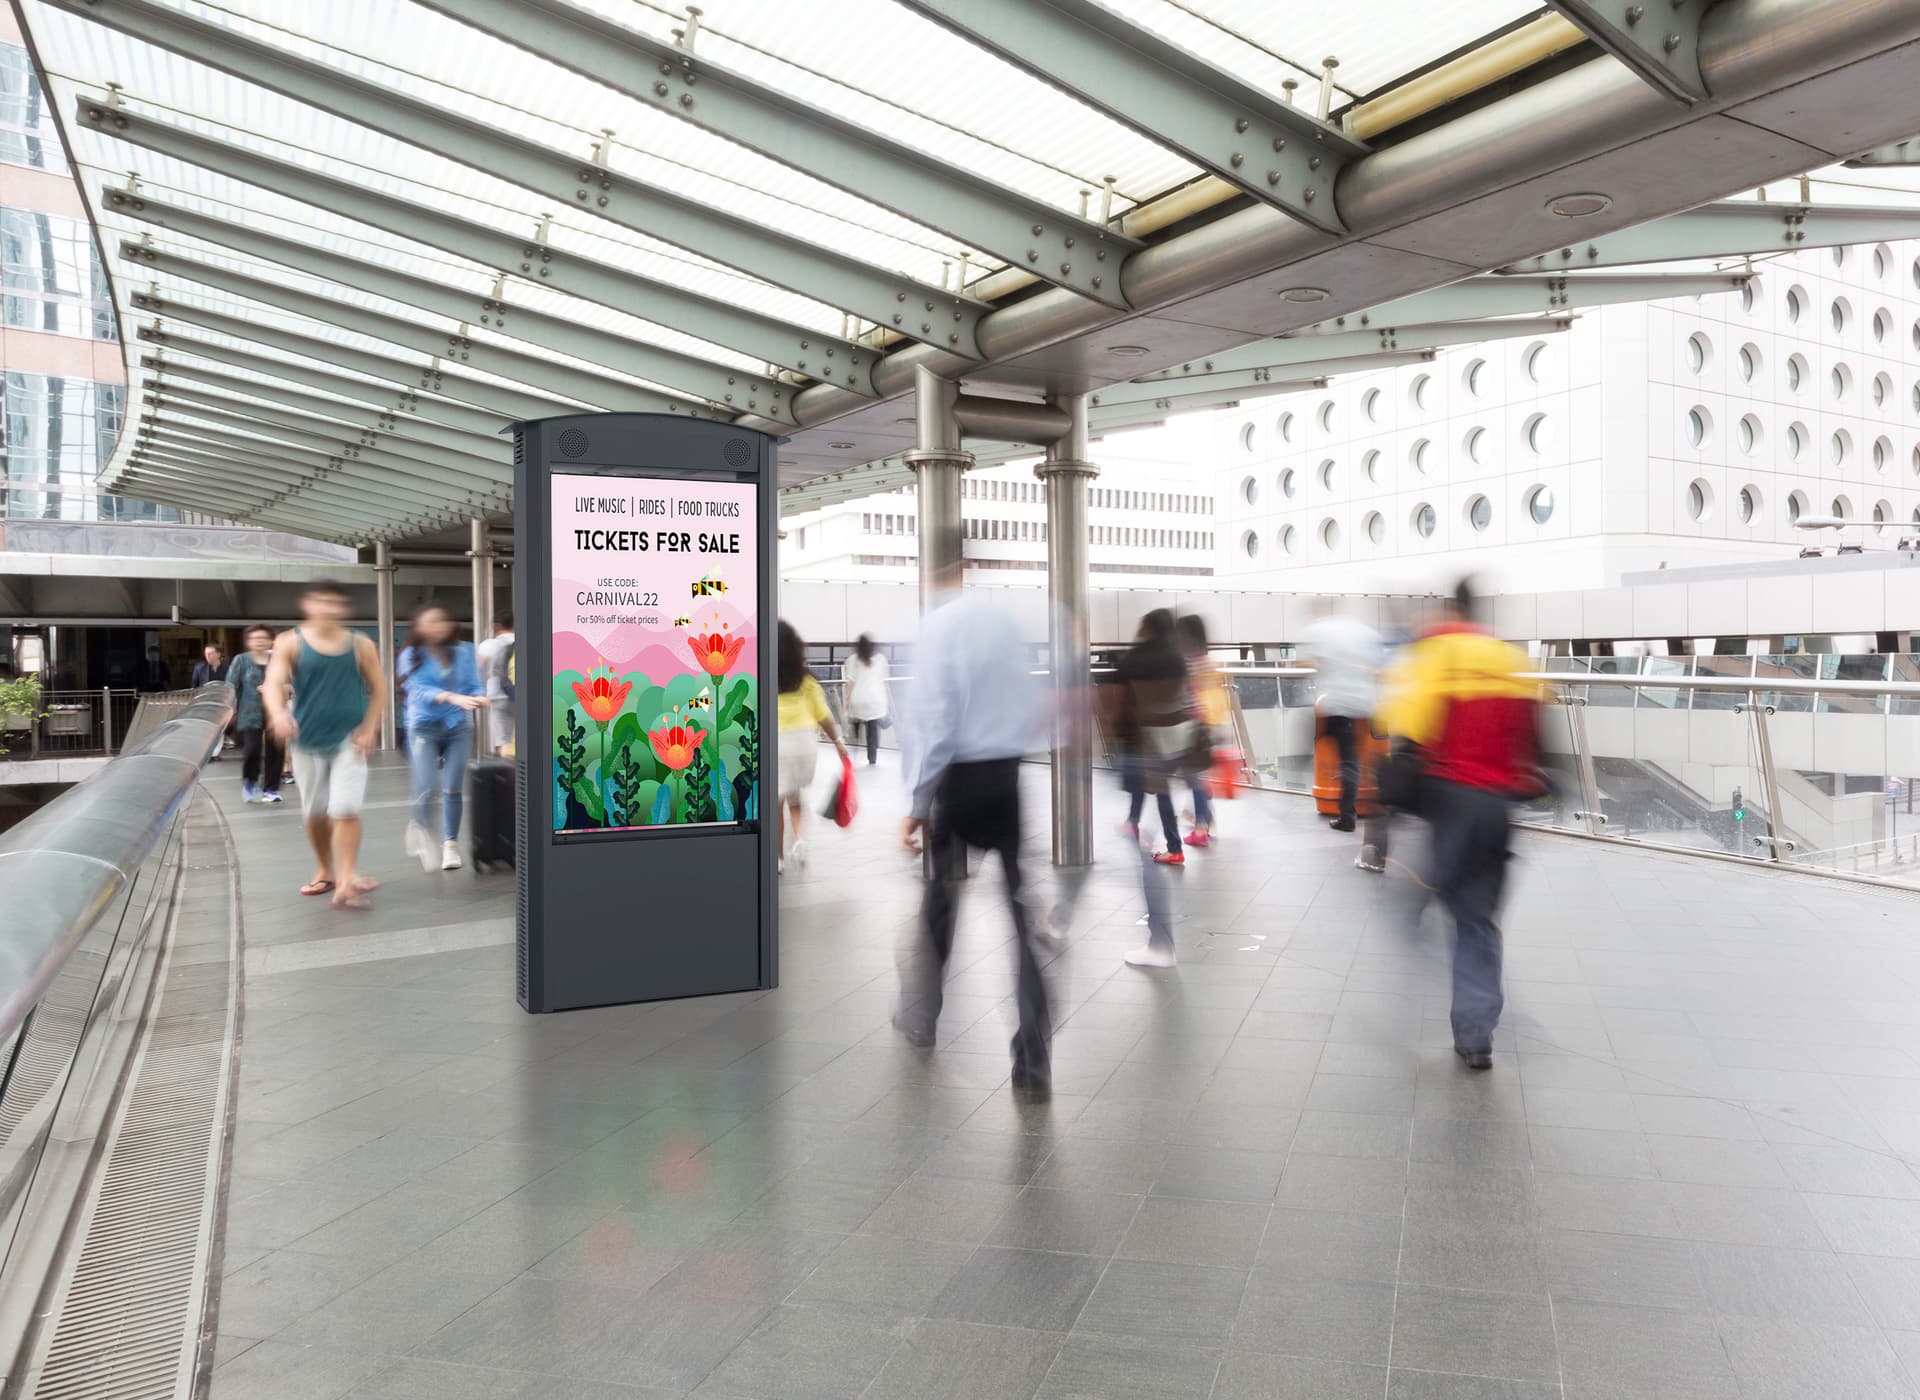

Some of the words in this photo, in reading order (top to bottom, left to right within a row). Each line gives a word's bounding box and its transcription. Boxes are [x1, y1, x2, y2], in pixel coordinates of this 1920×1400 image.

[575, 496, 596, 513] LIVE
[597, 497, 626, 514] MUSIC
[639, 499, 666, 516] RIDES
[678, 500, 702, 517] FOOD
[705, 501, 740, 518] TRUCKS
[574, 529, 649, 552] TICKETS
[656, 532, 691, 553] FOR
[698, 532, 740, 554] SALE
[597, 578, 613, 587] USE
[614, 578, 639, 588] CODE:
[576, 591, 659, 607] CARNIVAL22
[576, 615, 589, 624] For
[589, 615, 606, 624] 50%
[606, 615, 617, 624] off
[617, 615, 637, 625] ticket
[637, 616, 659, 625] prices
